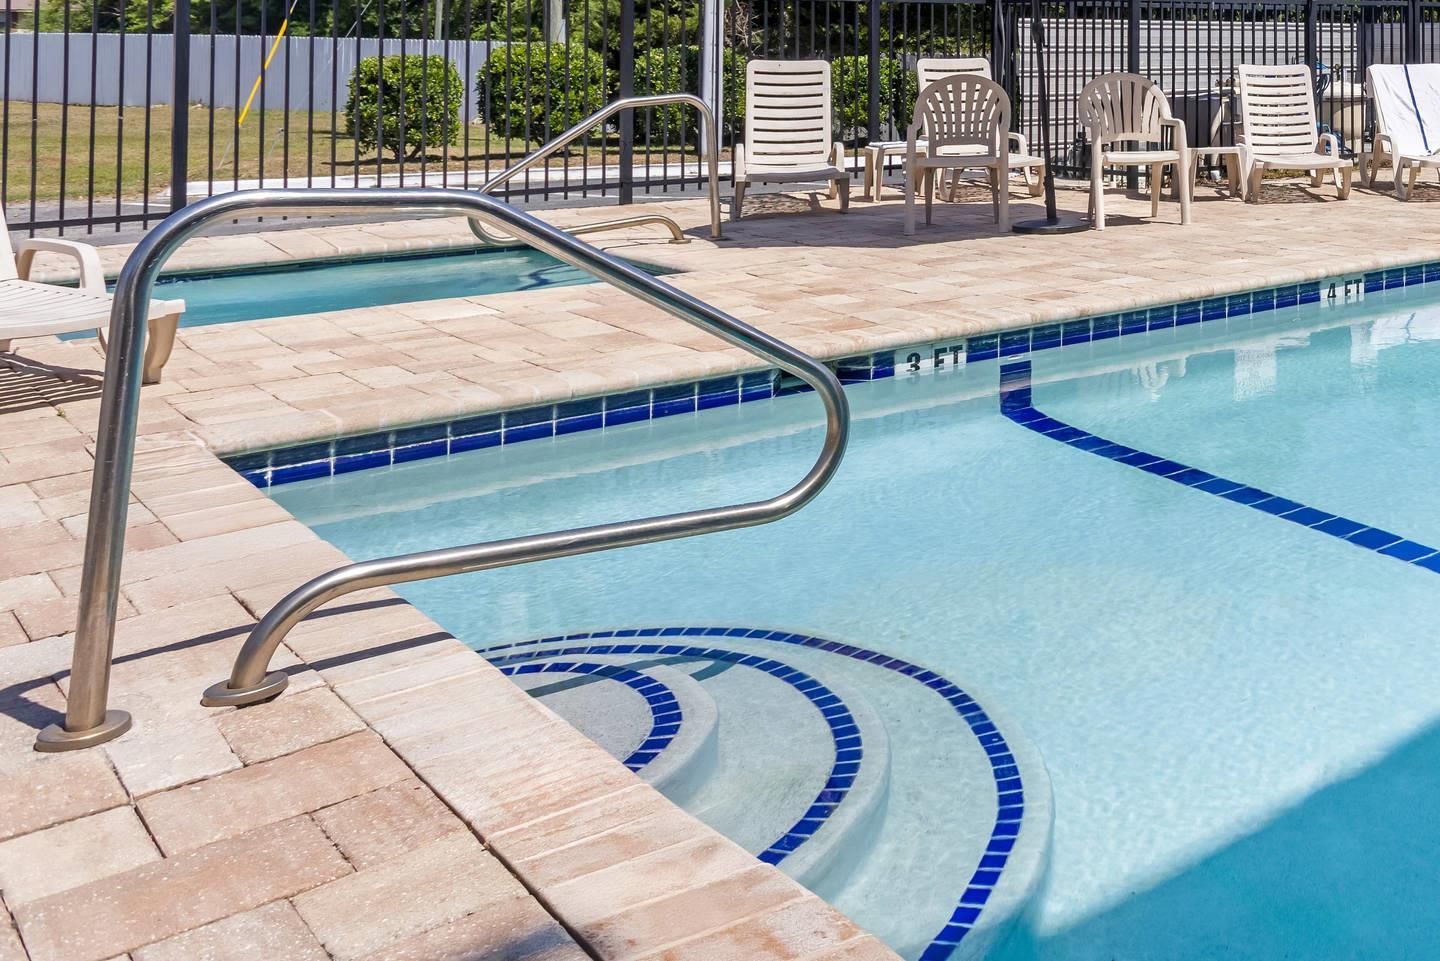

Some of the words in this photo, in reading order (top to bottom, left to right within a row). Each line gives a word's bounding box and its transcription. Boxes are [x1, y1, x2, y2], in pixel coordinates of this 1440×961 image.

[1327, 283, 1336, 298] 4
[1345, 279, 1362, 296] FT
[906, 352, 921, 372] 3
[933, 344, 963, 368] FT
